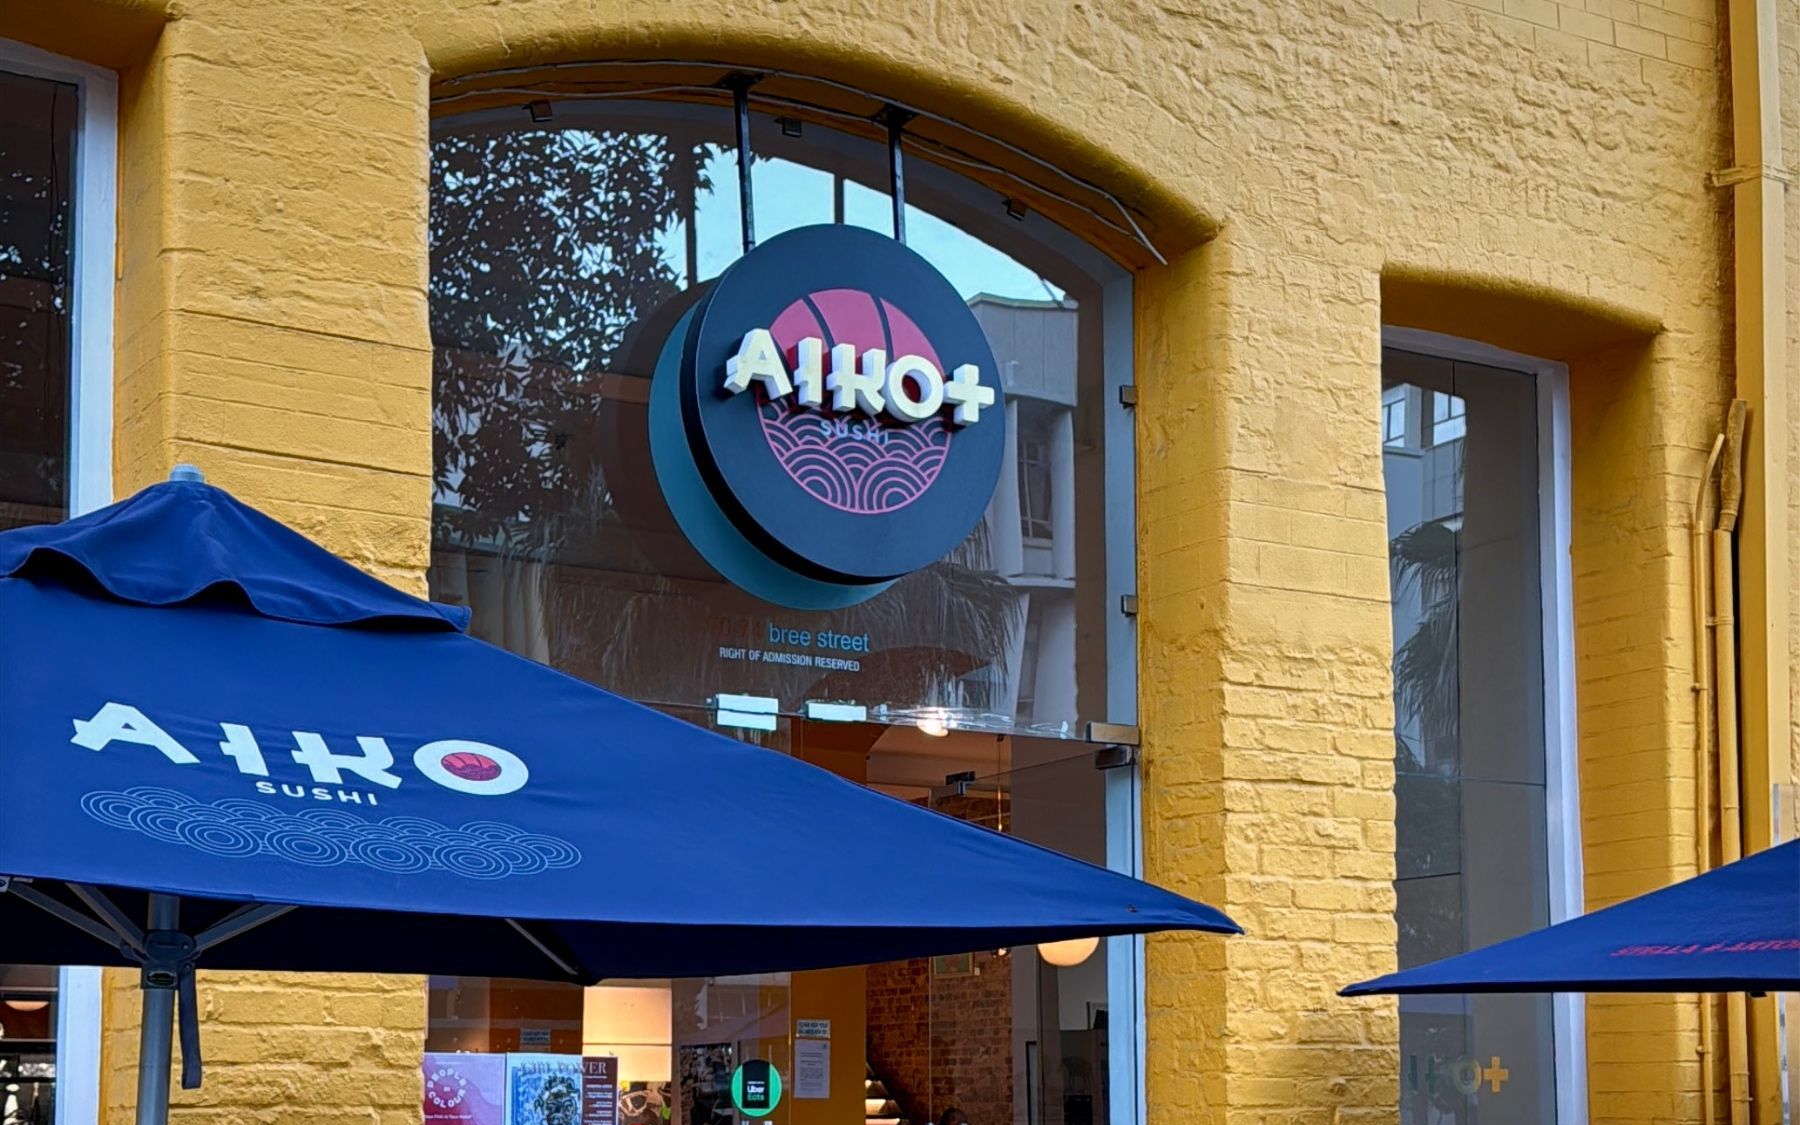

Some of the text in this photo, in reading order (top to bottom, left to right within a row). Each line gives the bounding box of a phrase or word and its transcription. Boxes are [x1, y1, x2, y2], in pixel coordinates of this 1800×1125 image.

[820, 419, 889, 446] SUSHI
[768, 622, 812, 647] bree
[816, 629, 870, 653] street
[719, 646, 861, 673] RIGHT OF ADMISSION RESERVED
[70, 700, 530, 796] AIKO
[255, 780, 378, 807] SUSHI
[427, 1068, 467, 1089] PEOPLE
[556, 1060, 607, 1075] POWER
[428, 1089, 467, 1109] COLOUR
[747, 1085, 765, 1094] Uber
